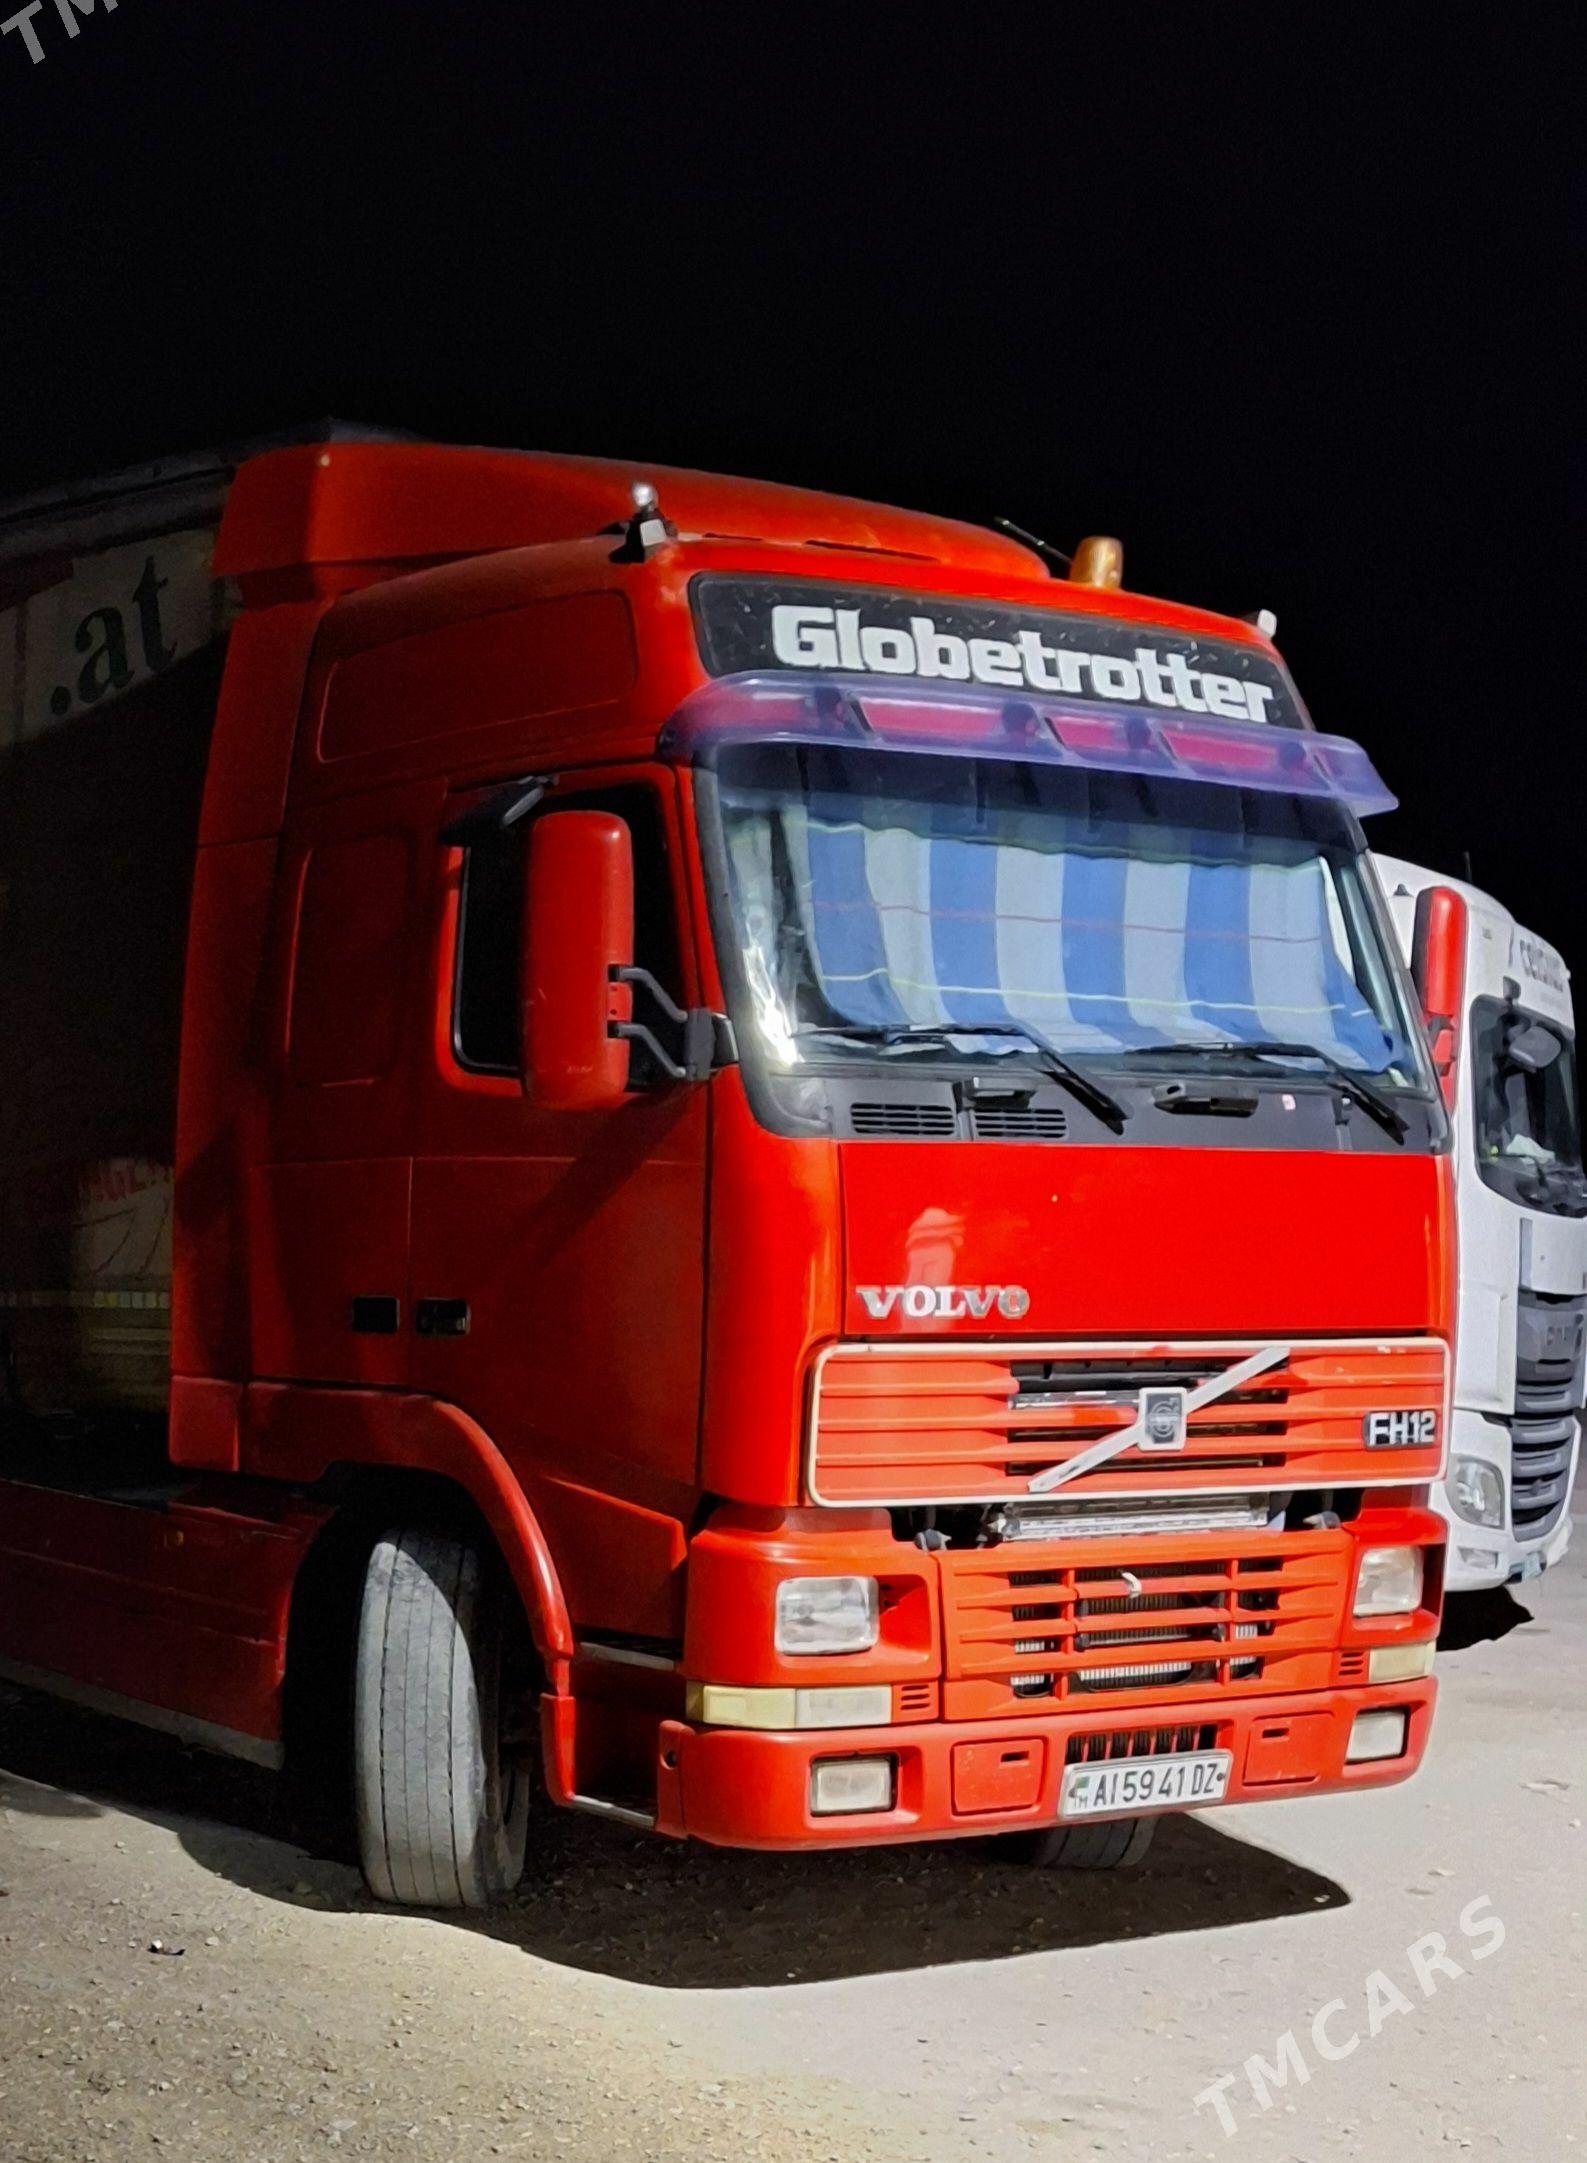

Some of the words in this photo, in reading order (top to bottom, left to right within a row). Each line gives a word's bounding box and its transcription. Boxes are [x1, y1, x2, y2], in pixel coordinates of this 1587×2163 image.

[51, 556, 178, 716] .at
[772, 605, 1273, 723] Globetrotter
[856, 1285, 1031, 1320] VOLVO
[1369, 1410, 1437, 1447] FH12
